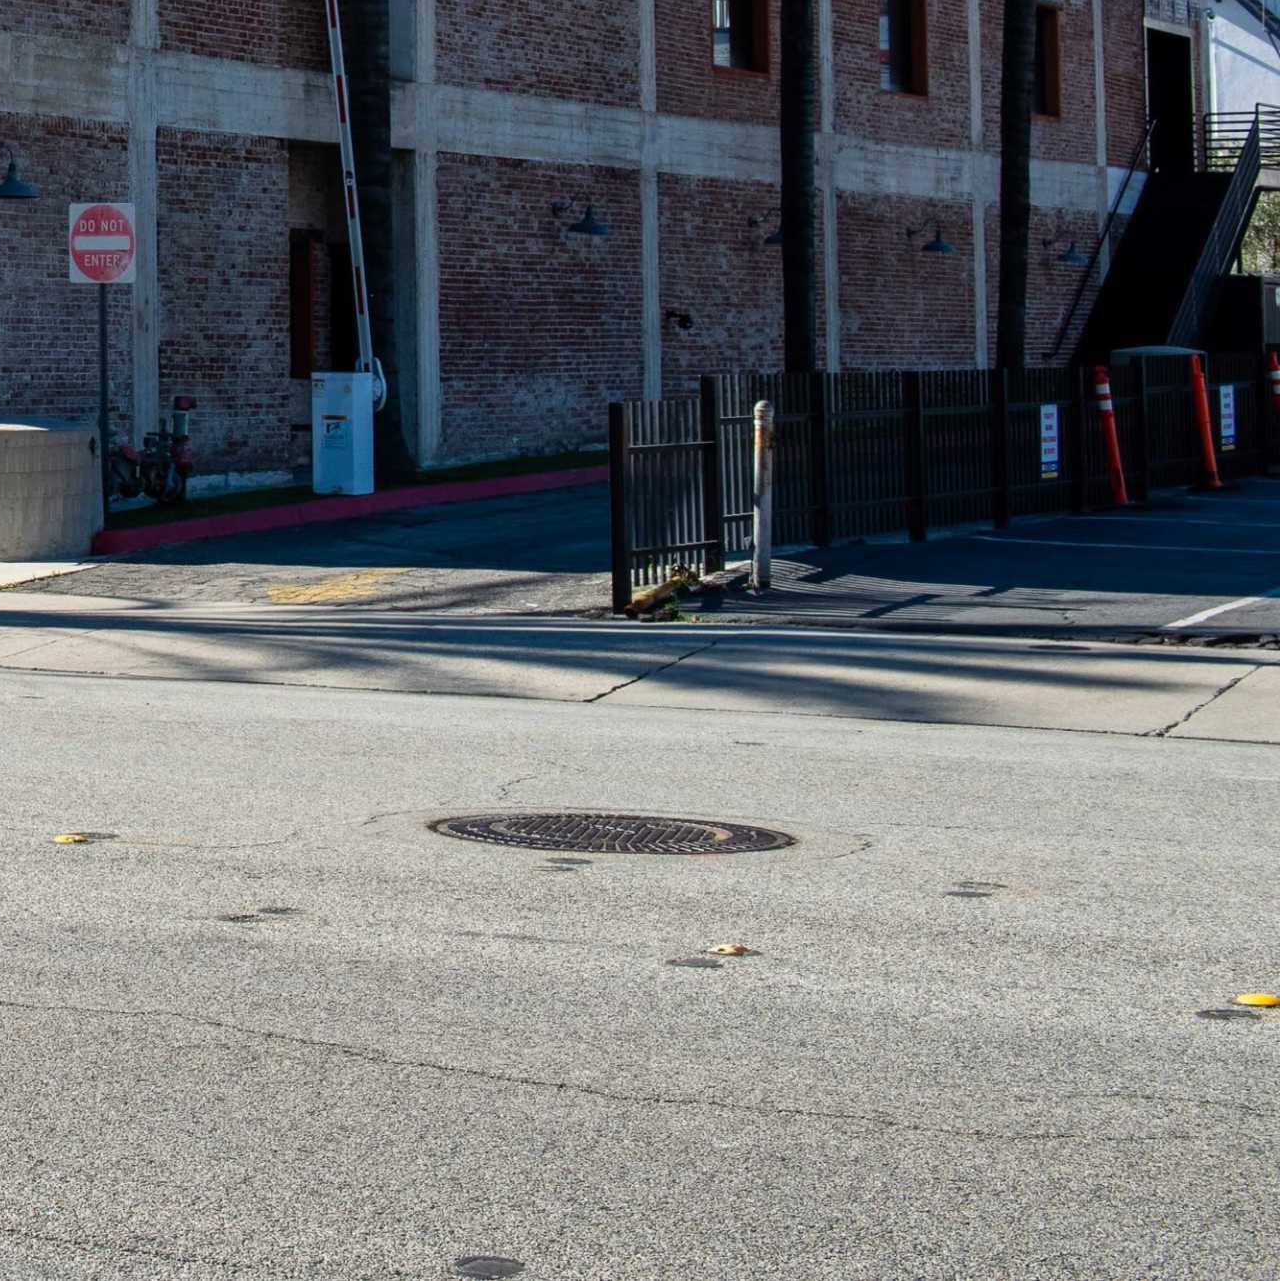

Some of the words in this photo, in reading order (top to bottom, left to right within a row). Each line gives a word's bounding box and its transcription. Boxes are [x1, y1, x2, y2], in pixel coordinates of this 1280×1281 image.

[80, 219, 96, 233] DO
[101, 219, 125, 232] NOT
[84, 254, 120, 267] ENTER
